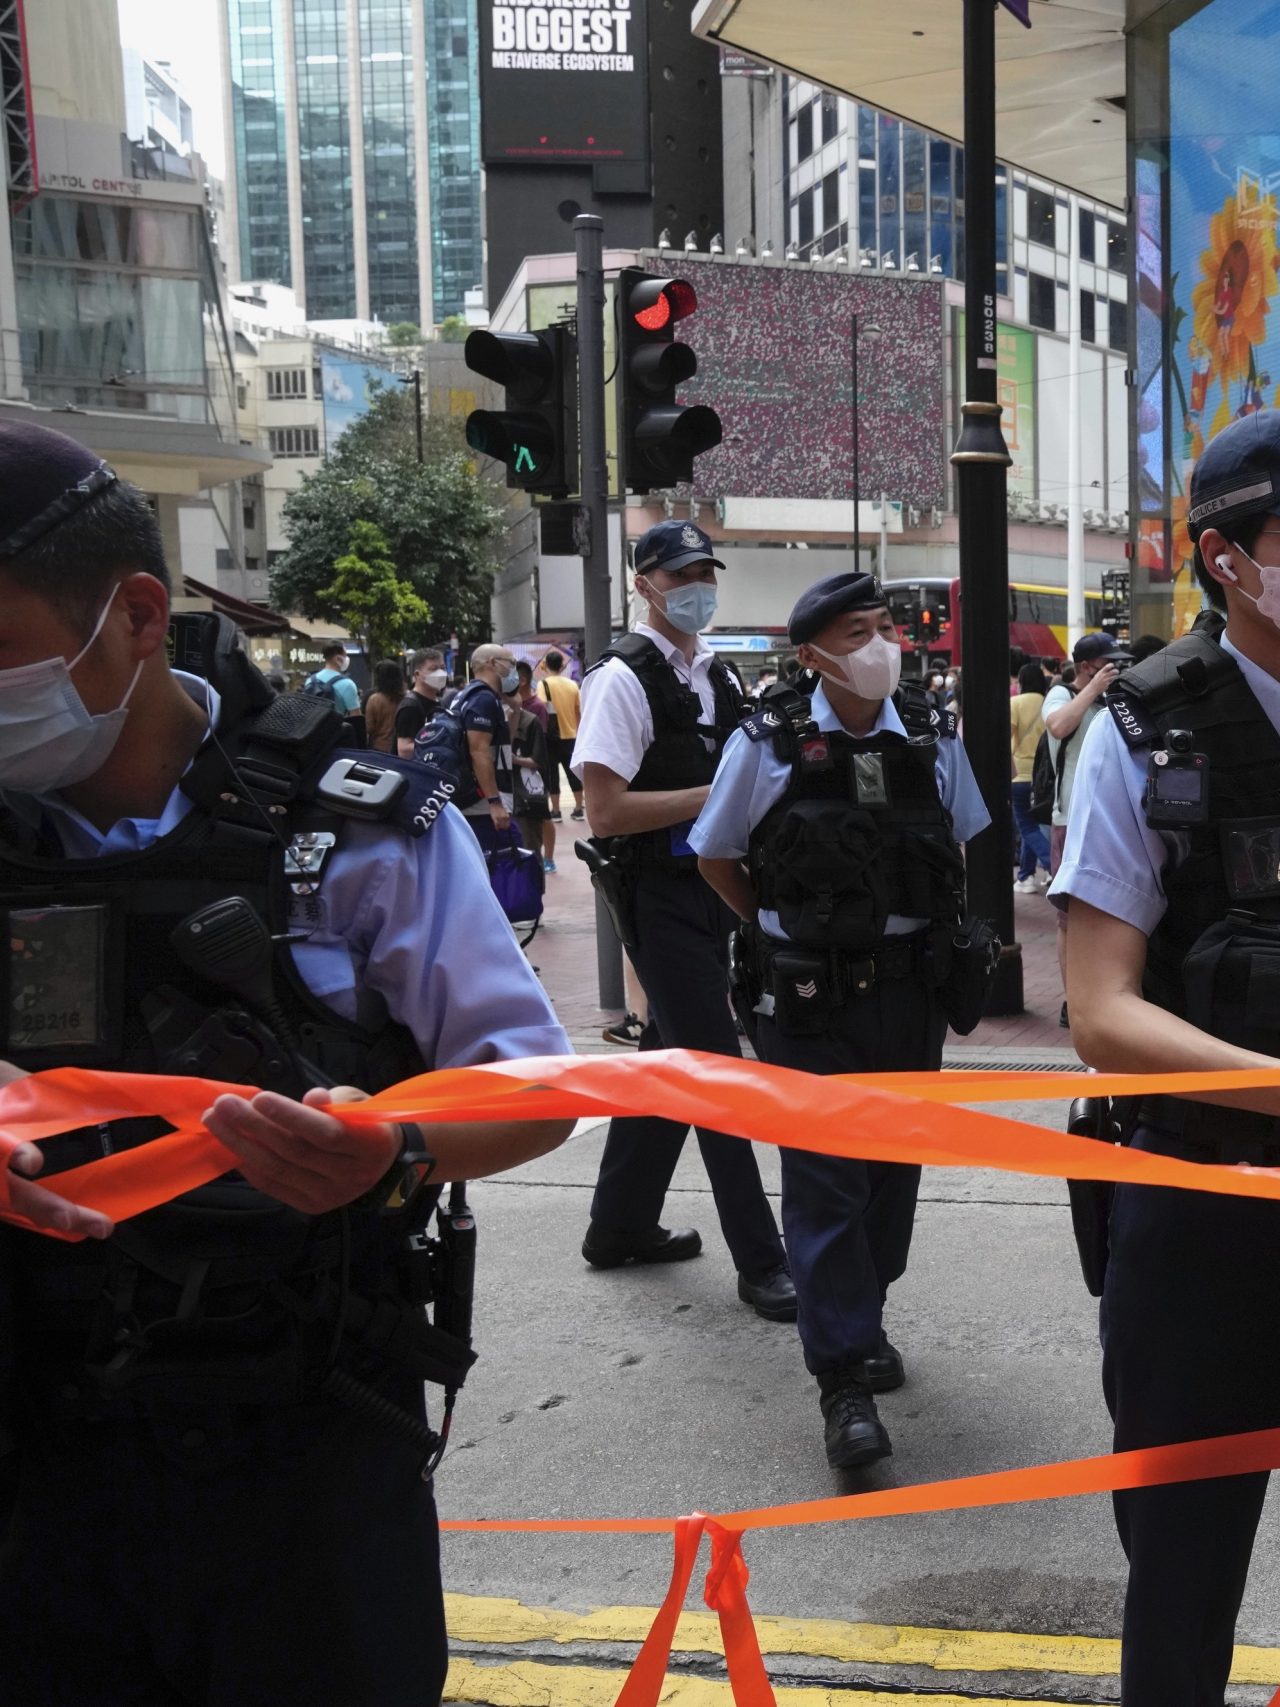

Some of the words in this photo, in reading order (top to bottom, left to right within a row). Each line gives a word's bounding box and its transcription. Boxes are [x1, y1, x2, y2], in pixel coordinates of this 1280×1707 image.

[492, 7, 632, 53] BIGGEST
[492, 51, 561, 70] METAVERSE
[563, 53, 634, 72] ECOSYSTEM
[41, 172, 86, 189] APITOL
[983, 295, 994, 353] 50238
[745, 720, 759, 736] 5376
[947, 714, 955, 732] 5376
[1113, 701, 1143, 736] 22819
[413, 780, 456, 830] 28216
[22, 1011, 82, 1031] 28216
